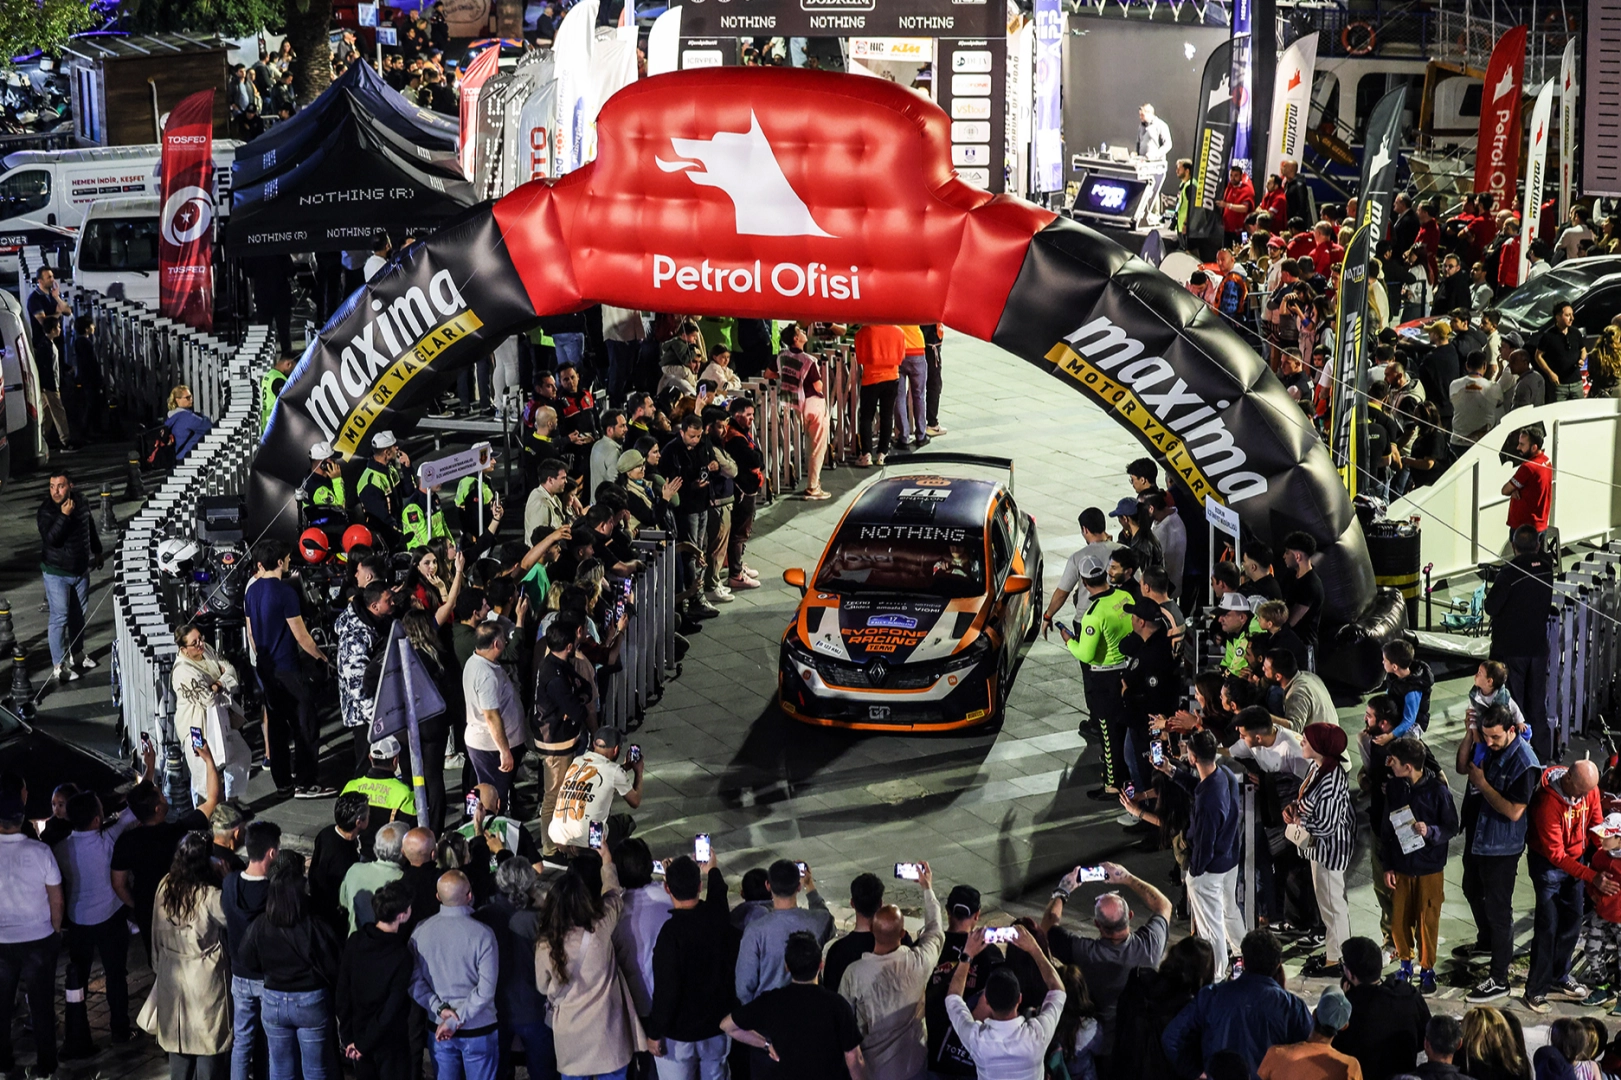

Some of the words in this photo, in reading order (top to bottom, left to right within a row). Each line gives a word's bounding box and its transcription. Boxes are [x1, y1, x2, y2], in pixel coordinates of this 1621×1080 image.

[720, 16, 776, 29] NOTHING
[809, 16, 866, 29] NOTHING
[898, 16, 955, 29] NOTHING
[1286, 103, 1298, 156] maxima
[167, 135, 207, 144] TOSFED
[1491, 109, 1511, 167] Petrol
[1202, 130, 1226, 212] maxima
[71, 178, 96, 186] HEMEN
[299, 188, 385, 205] NOTHING
[389, 187, 415, 199] (R)
[247, 231, 292, 244] NOTHING
[294, 231, 308, 240] (R)
[326, 227, 371, 238] NOTHING
[0, 235, 28, 245] OWER
[653, 254, 762, 293] Petrol
[771, 262, 861, 300] Ofisi
[304, 269, 468, 443] maxima
[344, 384, 393, 444] MOTOR
[391, 321, 466, 382] YAĞLARI
[1063, 315, 1268, 505] maxima
[1066, 358, 1137, 416] MOTOR
[1143, 419, 1212, 501] YAĞLARI
[860, 526, 966, 542] NOTHING
[840, 628, 928, 637] EVOFONE
[848, 636, 919, 646] RACING
[563, 780, 594, 793] SAGA
